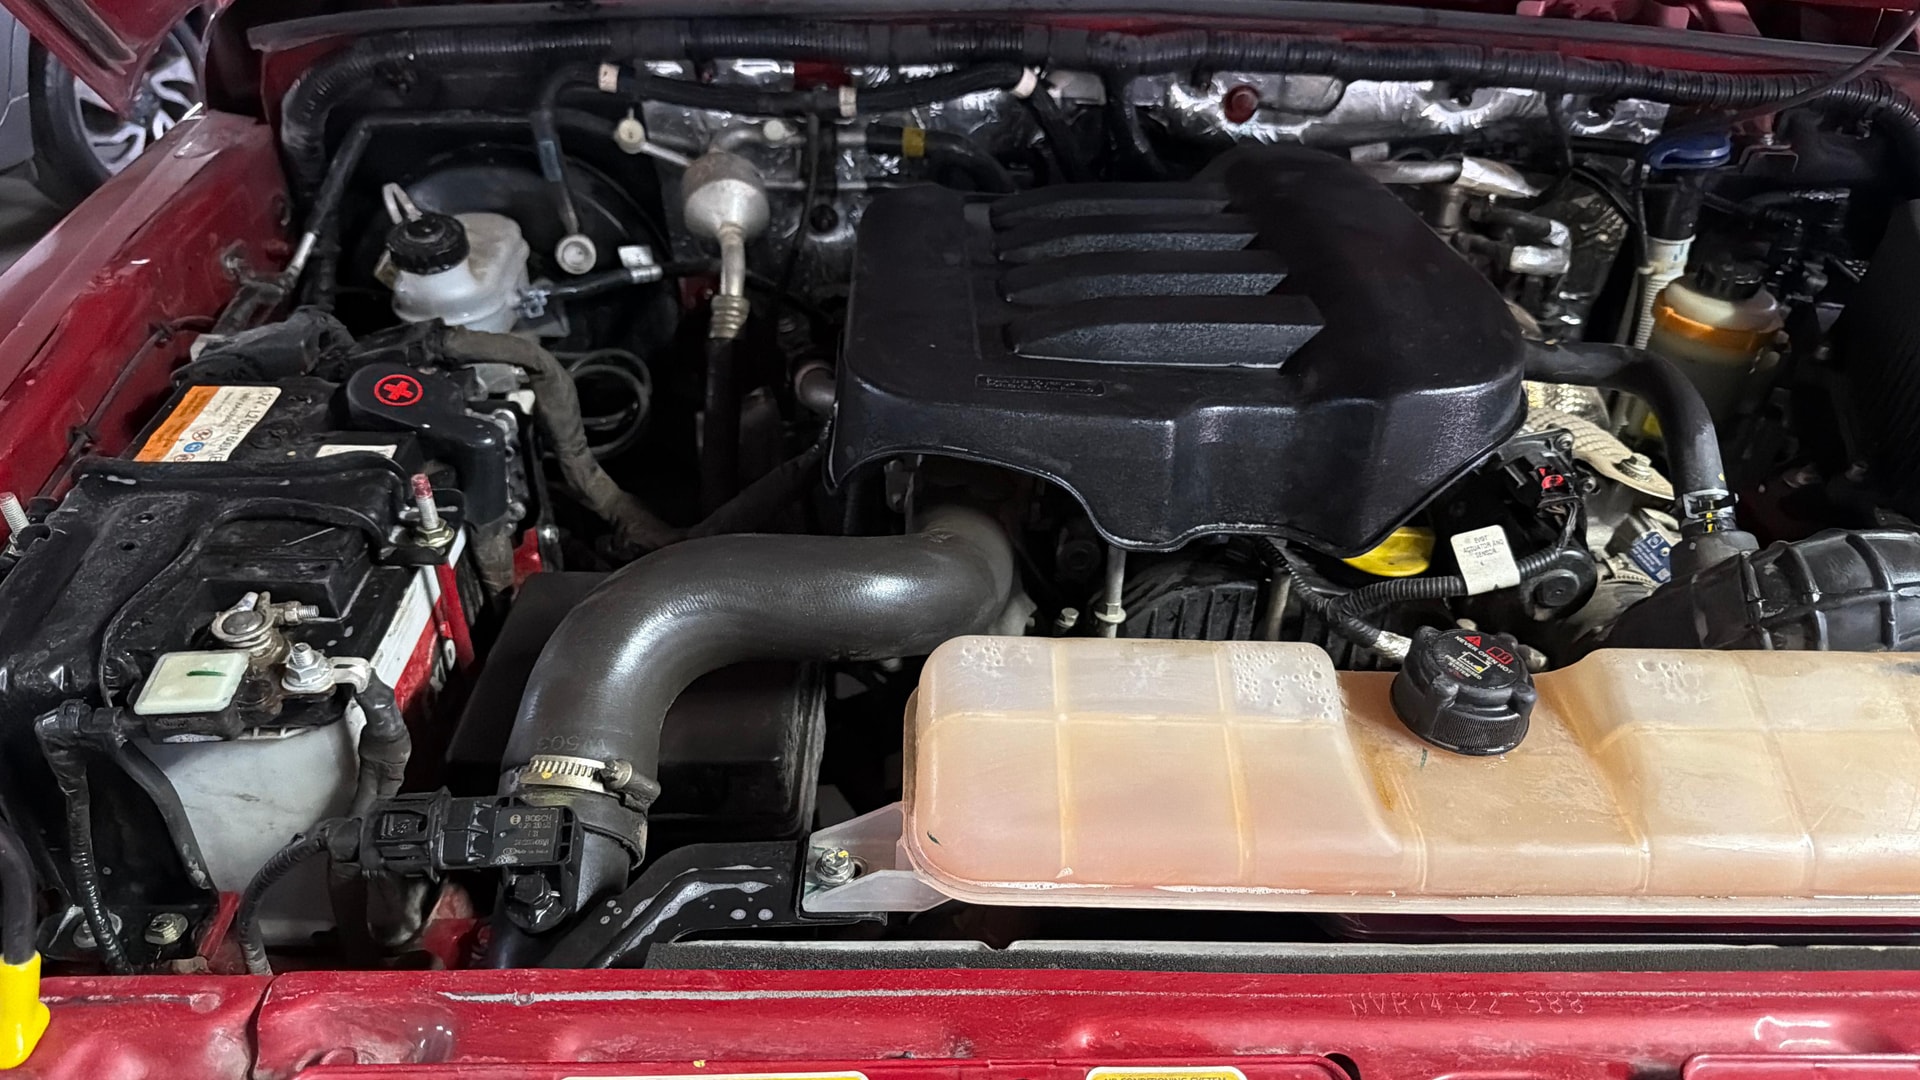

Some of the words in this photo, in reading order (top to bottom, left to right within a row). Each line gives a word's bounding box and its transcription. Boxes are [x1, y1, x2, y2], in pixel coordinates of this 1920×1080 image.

[1492, 538, 1504, 546] AND
[1454, 635, 1479, 652] NEVER
[1478, 650, 1498, 665] OPEN
[1497, 664, 1515, 674] HOT
[1448, 661, 1472, 677] SYSTEM
[525, 814, 552, 822] BOSCH
